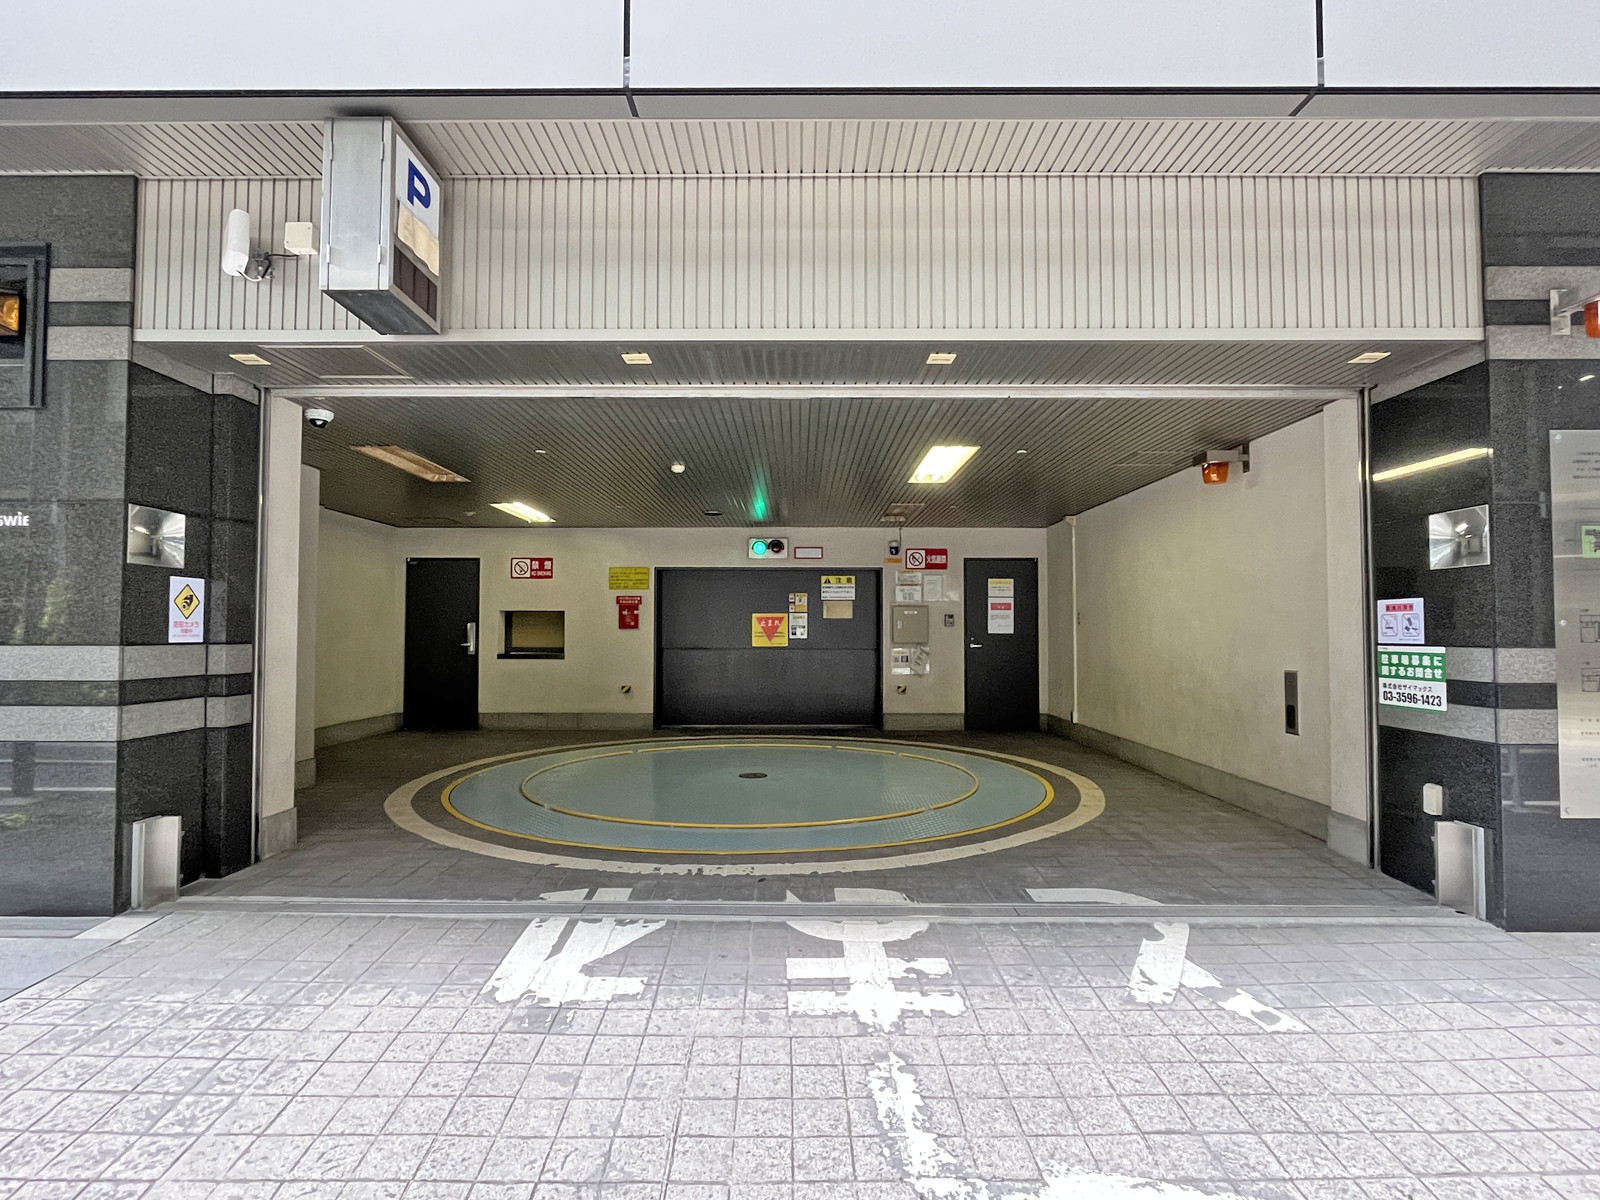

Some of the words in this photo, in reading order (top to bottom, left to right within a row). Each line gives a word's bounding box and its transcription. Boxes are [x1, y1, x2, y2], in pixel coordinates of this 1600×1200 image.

[407, 158, 431, 209] P
[759, 619, 780, 627] 止まれ
[1381, 665, 1442, 679] 関するお問合せ
[1382, 682, 1433, 693] 株式会社ザイマックス
[1383, 690, 1442, 707] 03-3596-1423
